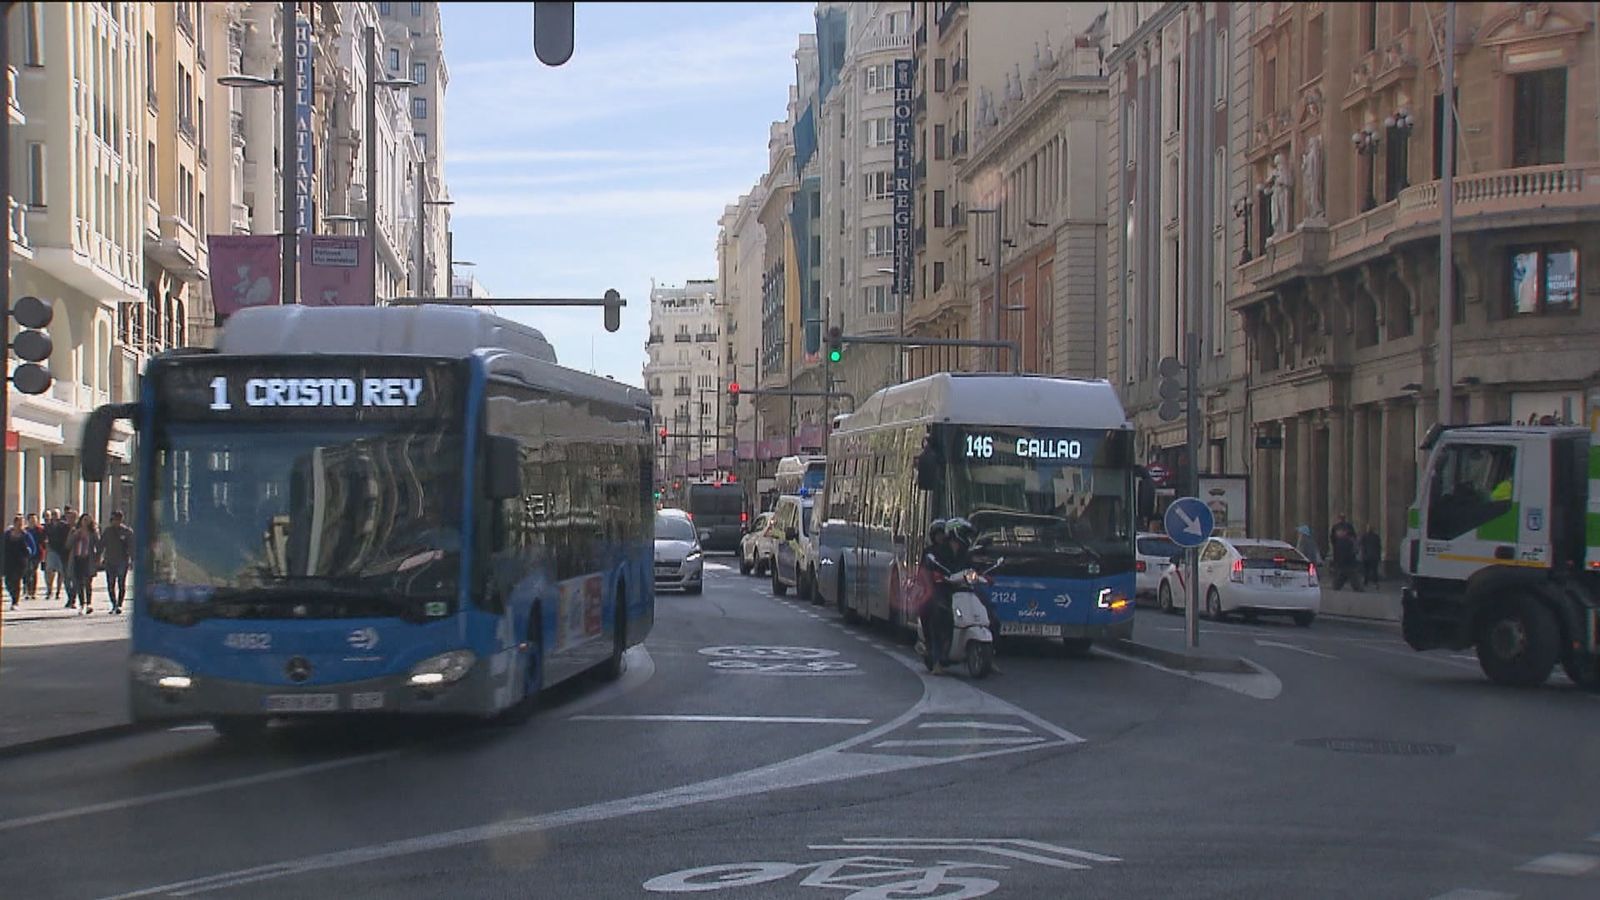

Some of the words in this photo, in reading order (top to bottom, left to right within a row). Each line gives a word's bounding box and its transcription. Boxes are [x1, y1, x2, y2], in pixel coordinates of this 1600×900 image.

[295, 26, 308, 105] HOTEL
[895, 88, 911, 169] HOTEL
[295, 117, 309, 236] ATLANTIC
[209, 376, 232, 410] 1
[245, 377, 357, 407] CRISTO
[361, 377, 423, 407] REY
[965, 434, 994, 459] 146
[1016, 437, 1081, 459] CALLAO
[991, 591, 1017, 604] 2124
